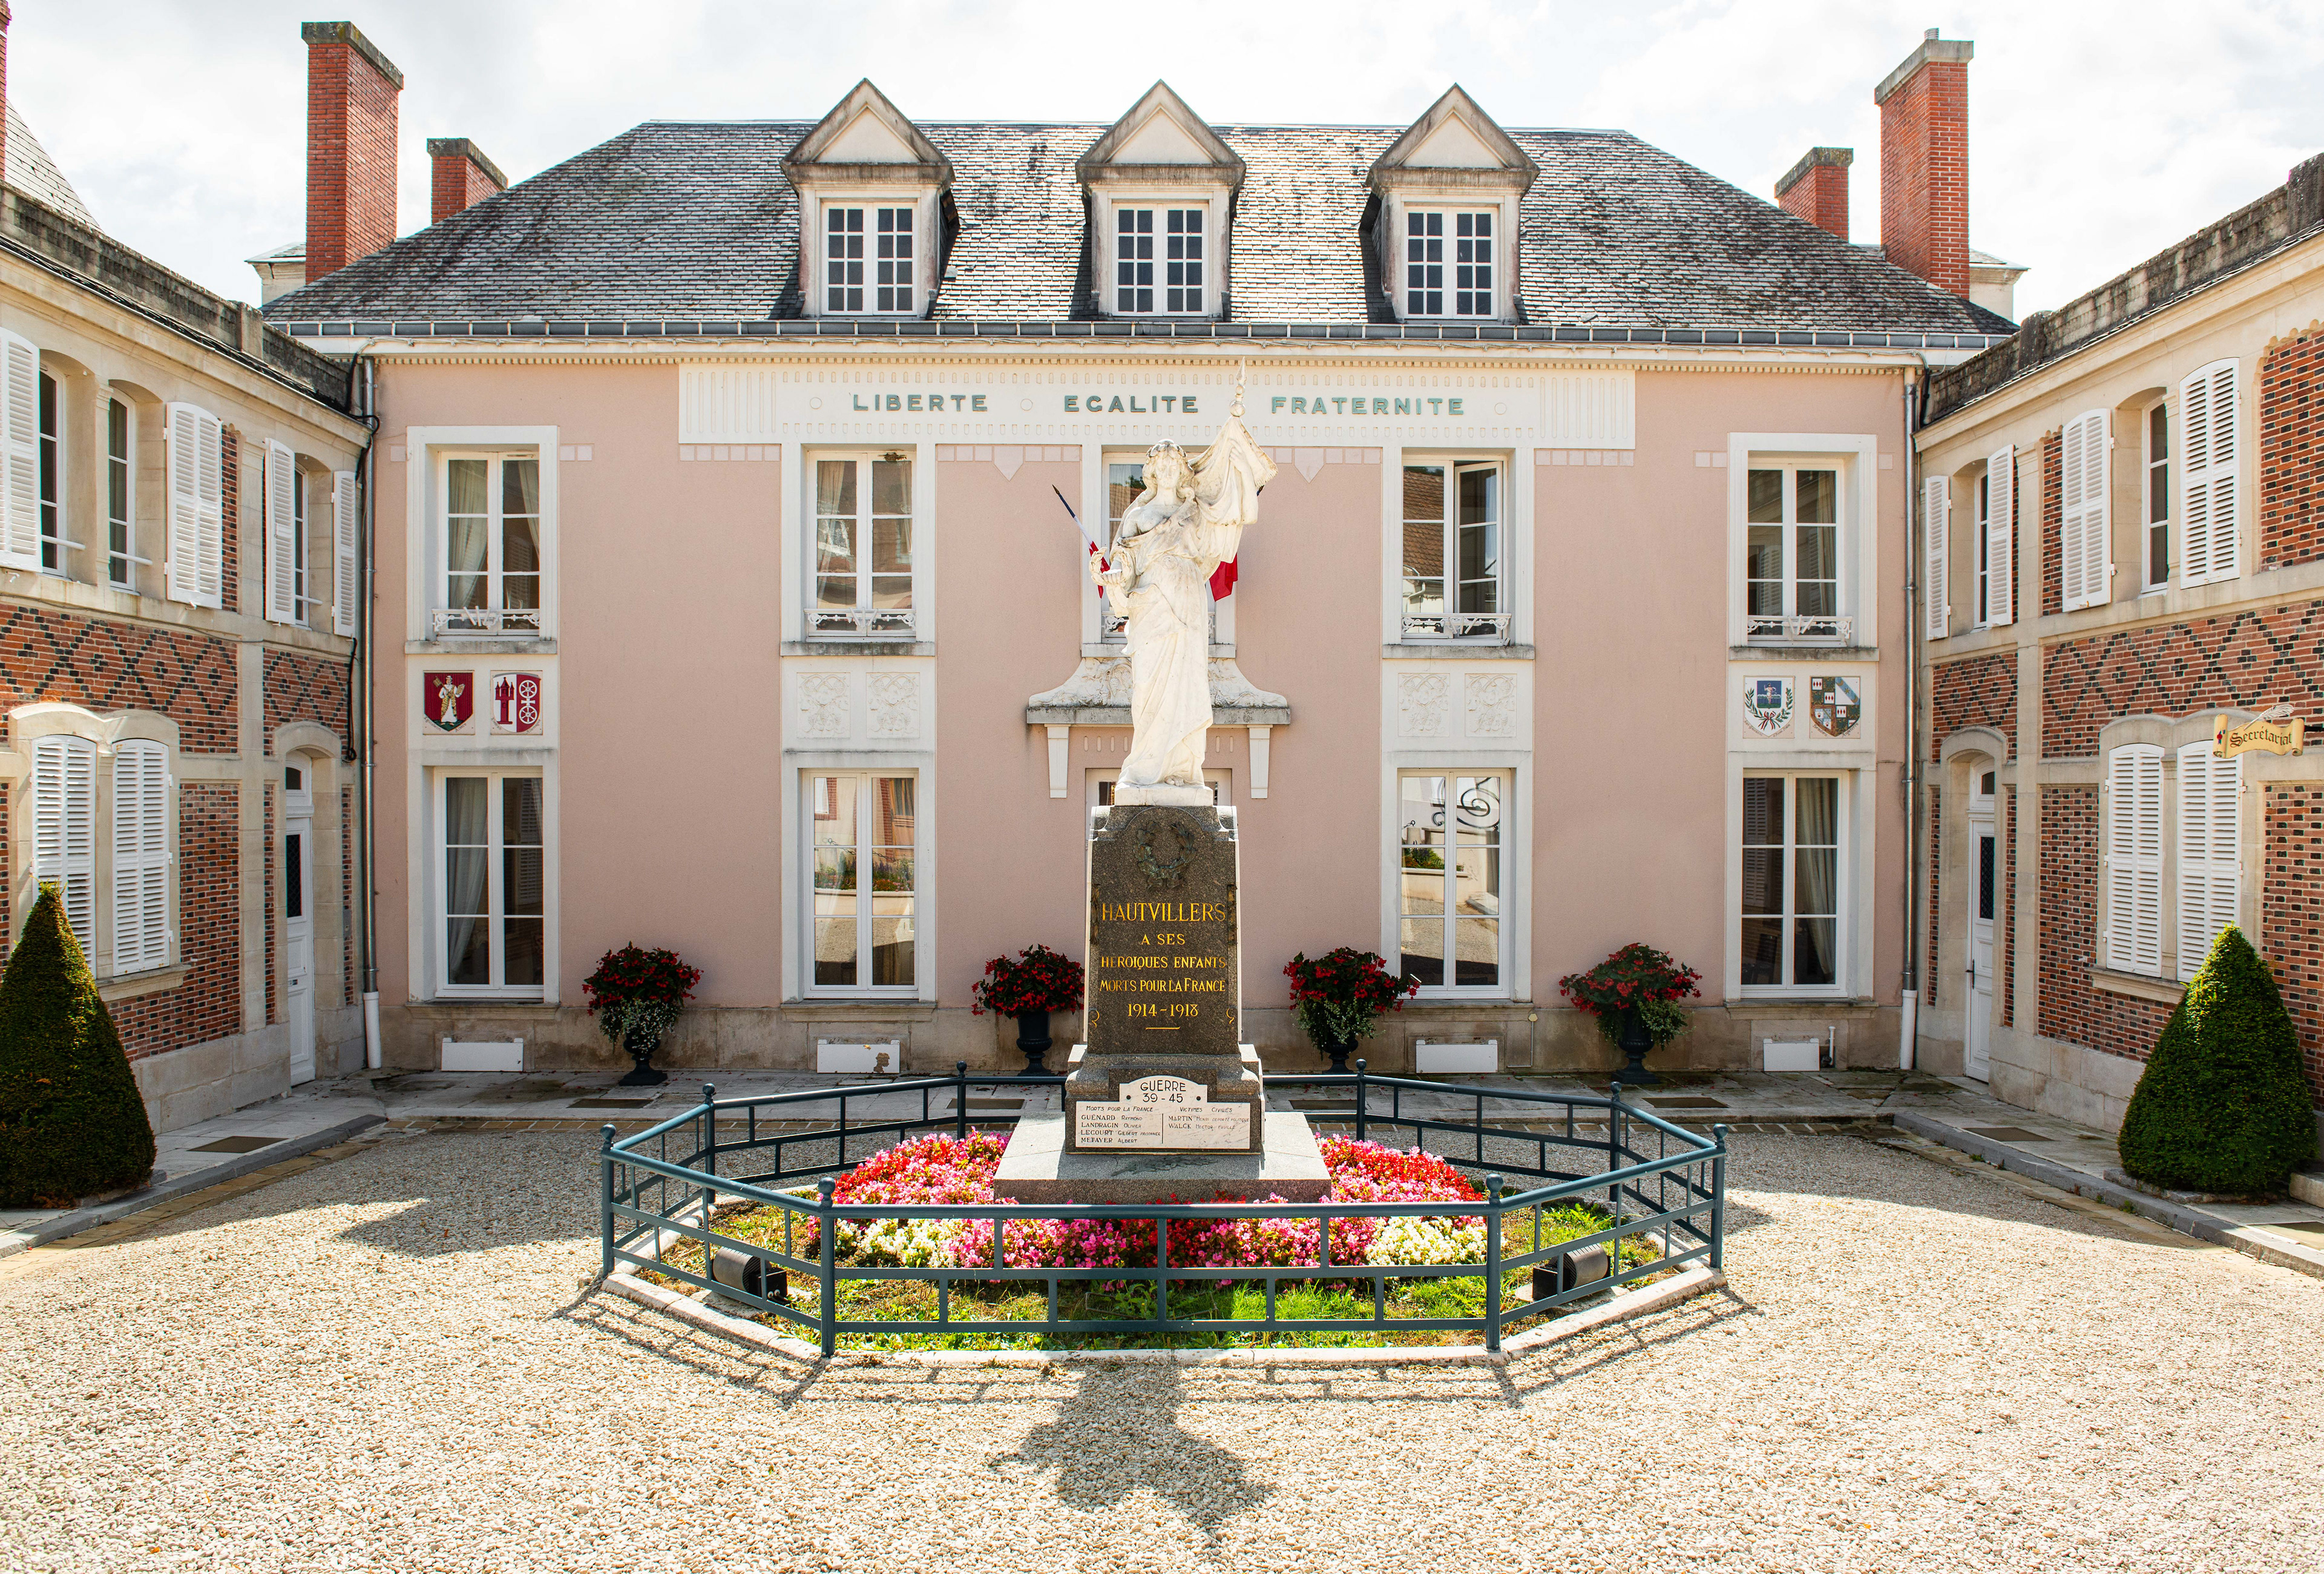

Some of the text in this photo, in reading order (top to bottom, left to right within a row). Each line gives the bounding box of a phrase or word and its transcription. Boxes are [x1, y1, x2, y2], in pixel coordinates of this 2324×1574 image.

[853, 394, 1464, 415] LIBERTE EGALITE FRATERNITE
[2230, 726, 2293, 748] Secrétariat
[1101, 903, 1226, 921] HAUTVILLERS
[1141, 934, 1186, 945] A SES
[1101, 957, 1226, 970] HEROIQUES ENFANTS
[1100, 978, 1226, 992] MORTS POUR LA FRANCE
[1140, 1080, 1186, 1092] GUERRE
